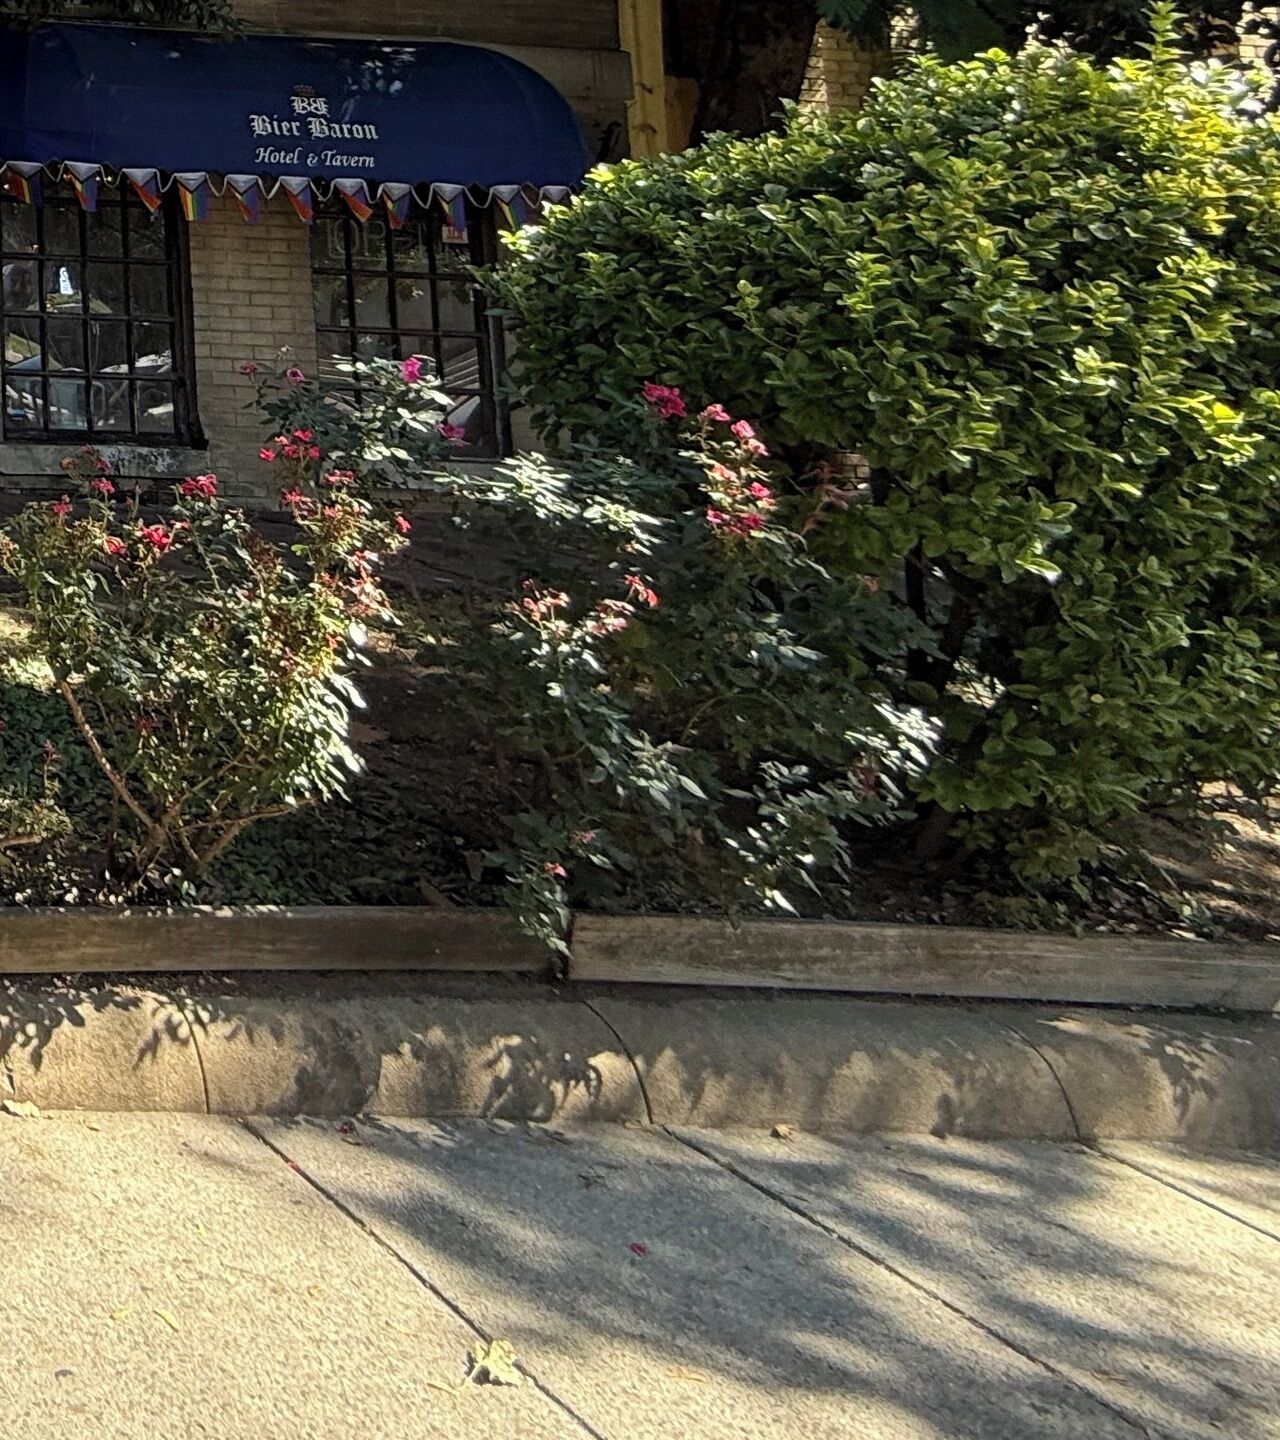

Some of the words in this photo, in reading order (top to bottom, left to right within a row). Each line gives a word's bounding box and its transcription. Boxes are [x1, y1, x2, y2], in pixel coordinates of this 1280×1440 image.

[249, 115, 300, 138] Bier
[306, 118, 379, 140] Baron
[254, 147, 303, 165] Hotel
[307, 153, 319, 167] &
[321, 150, 375, 168] Tavern
